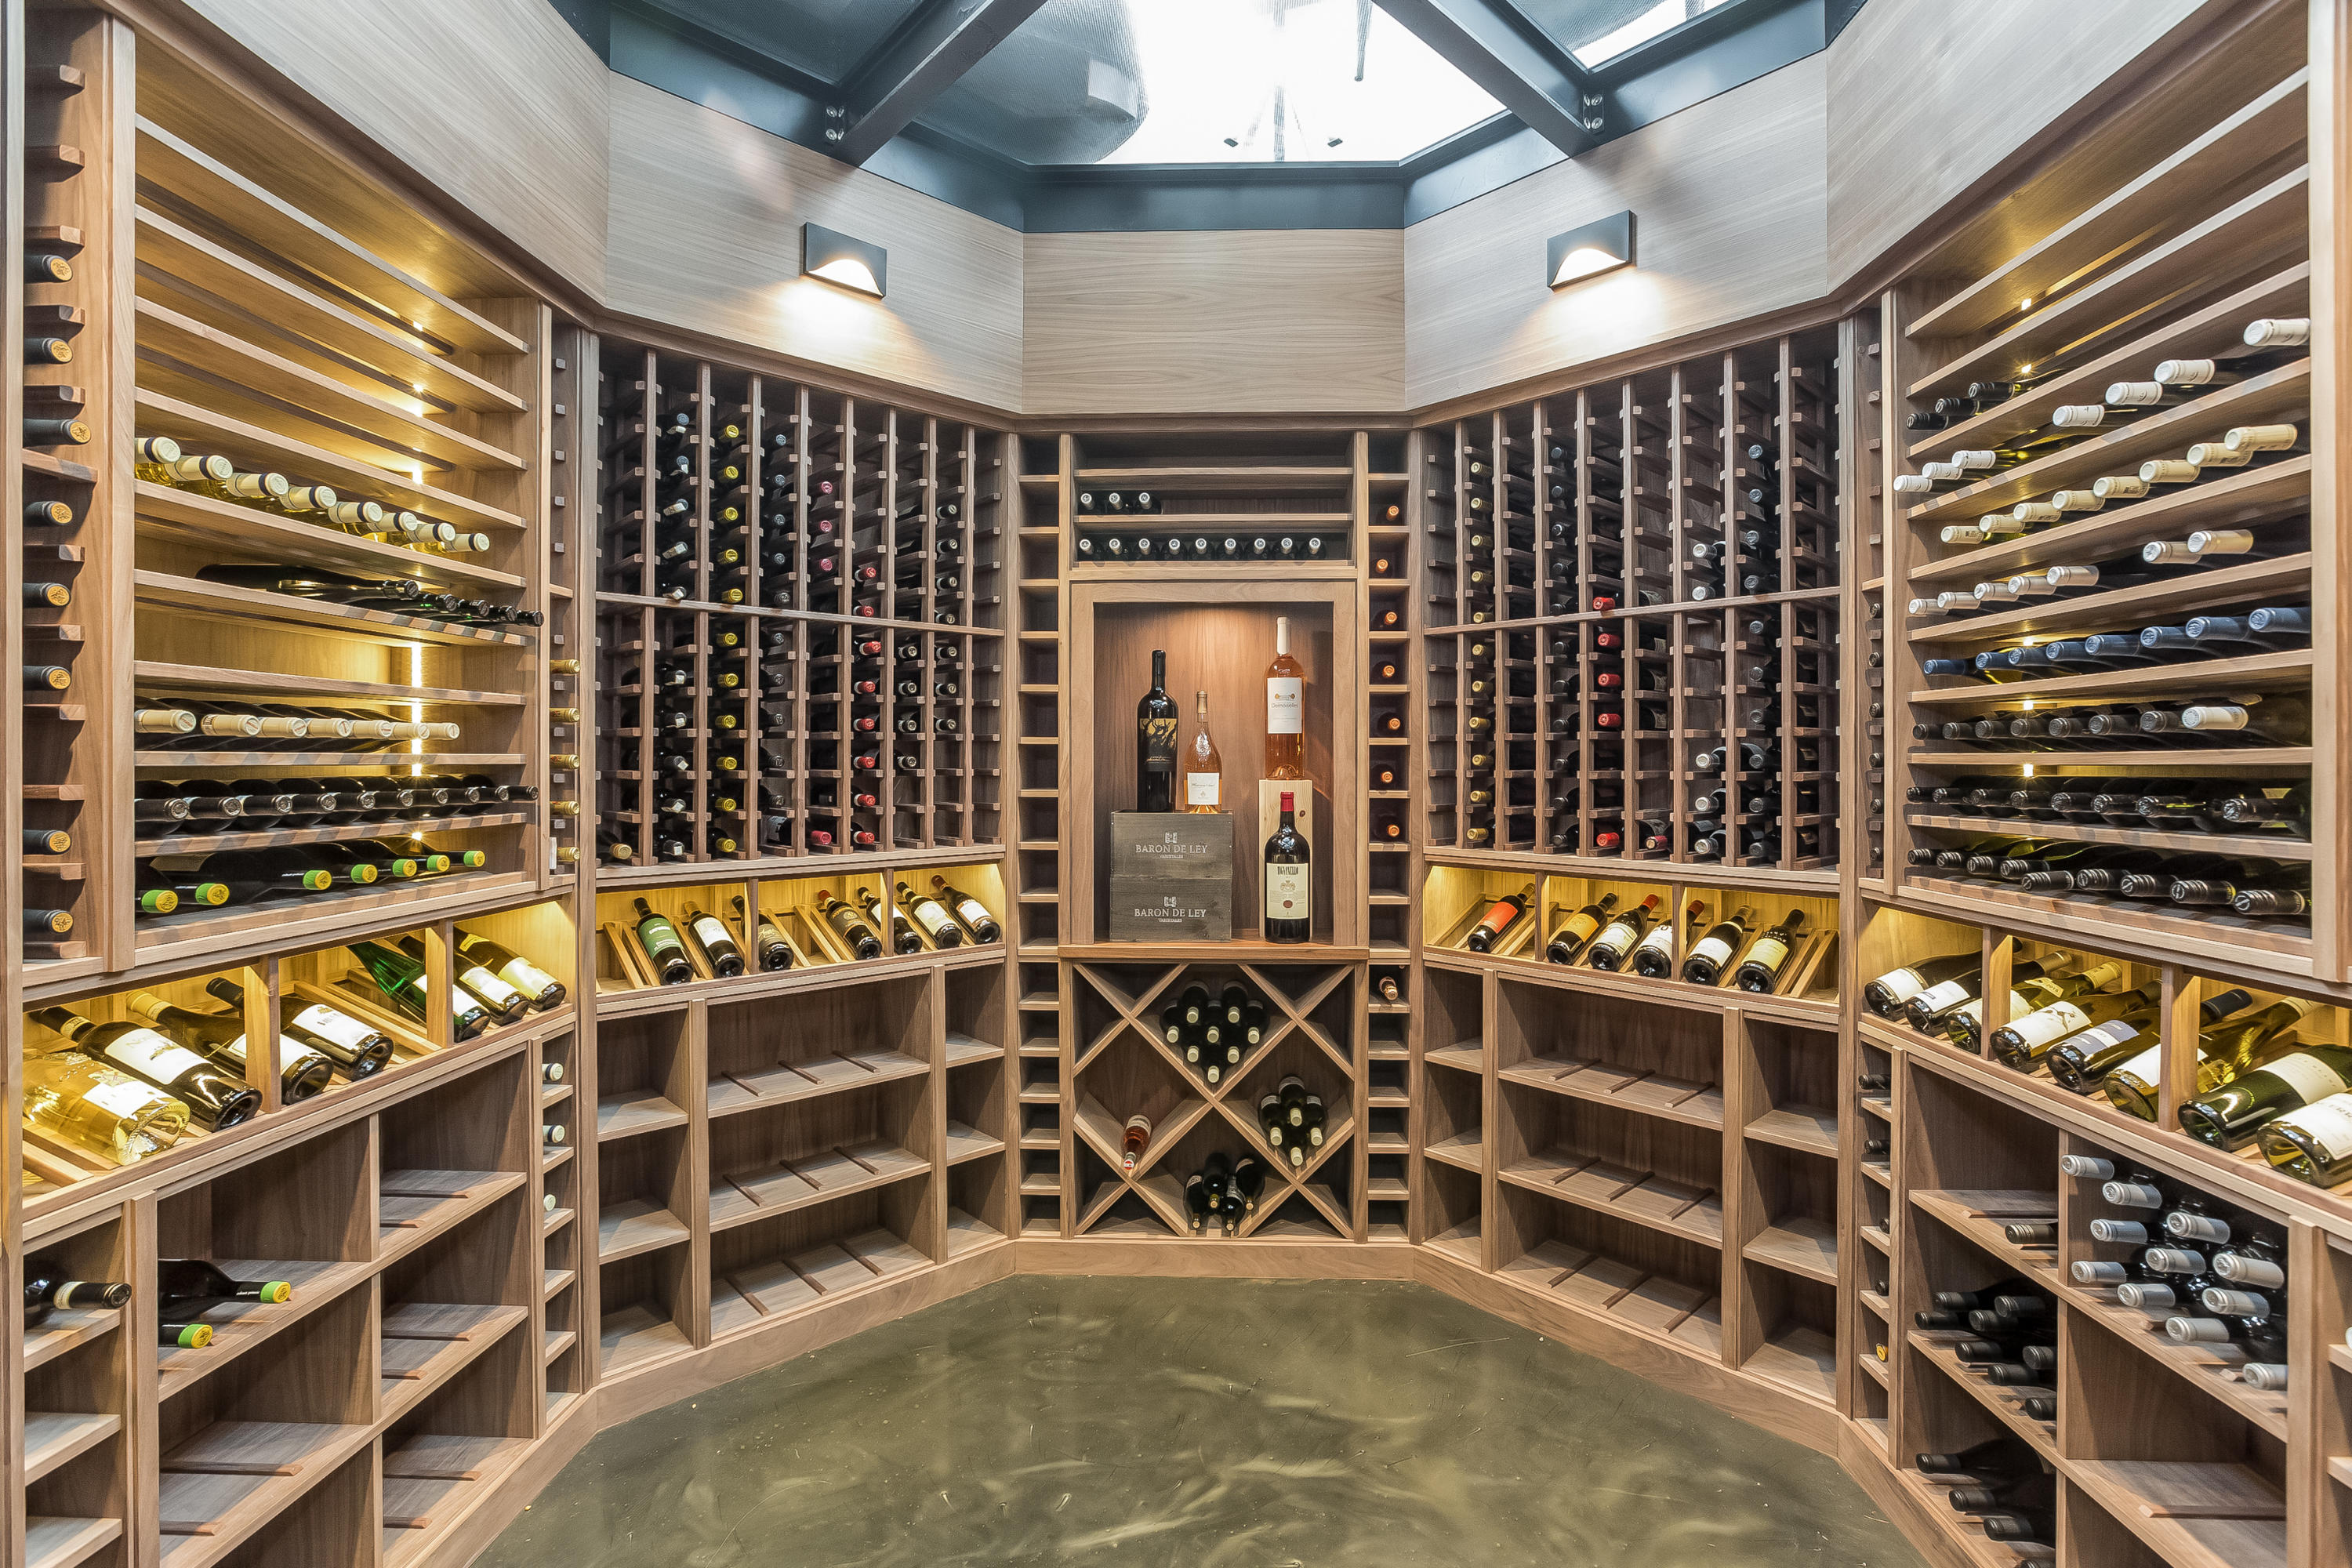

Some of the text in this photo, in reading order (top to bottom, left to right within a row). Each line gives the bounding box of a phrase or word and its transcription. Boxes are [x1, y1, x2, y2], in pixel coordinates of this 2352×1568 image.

[1135, 844, 1208, 854] BARON DE LEY
[1134, 908, 1170, 916] BARON
[1188, 909, 1207, 917] LEY
